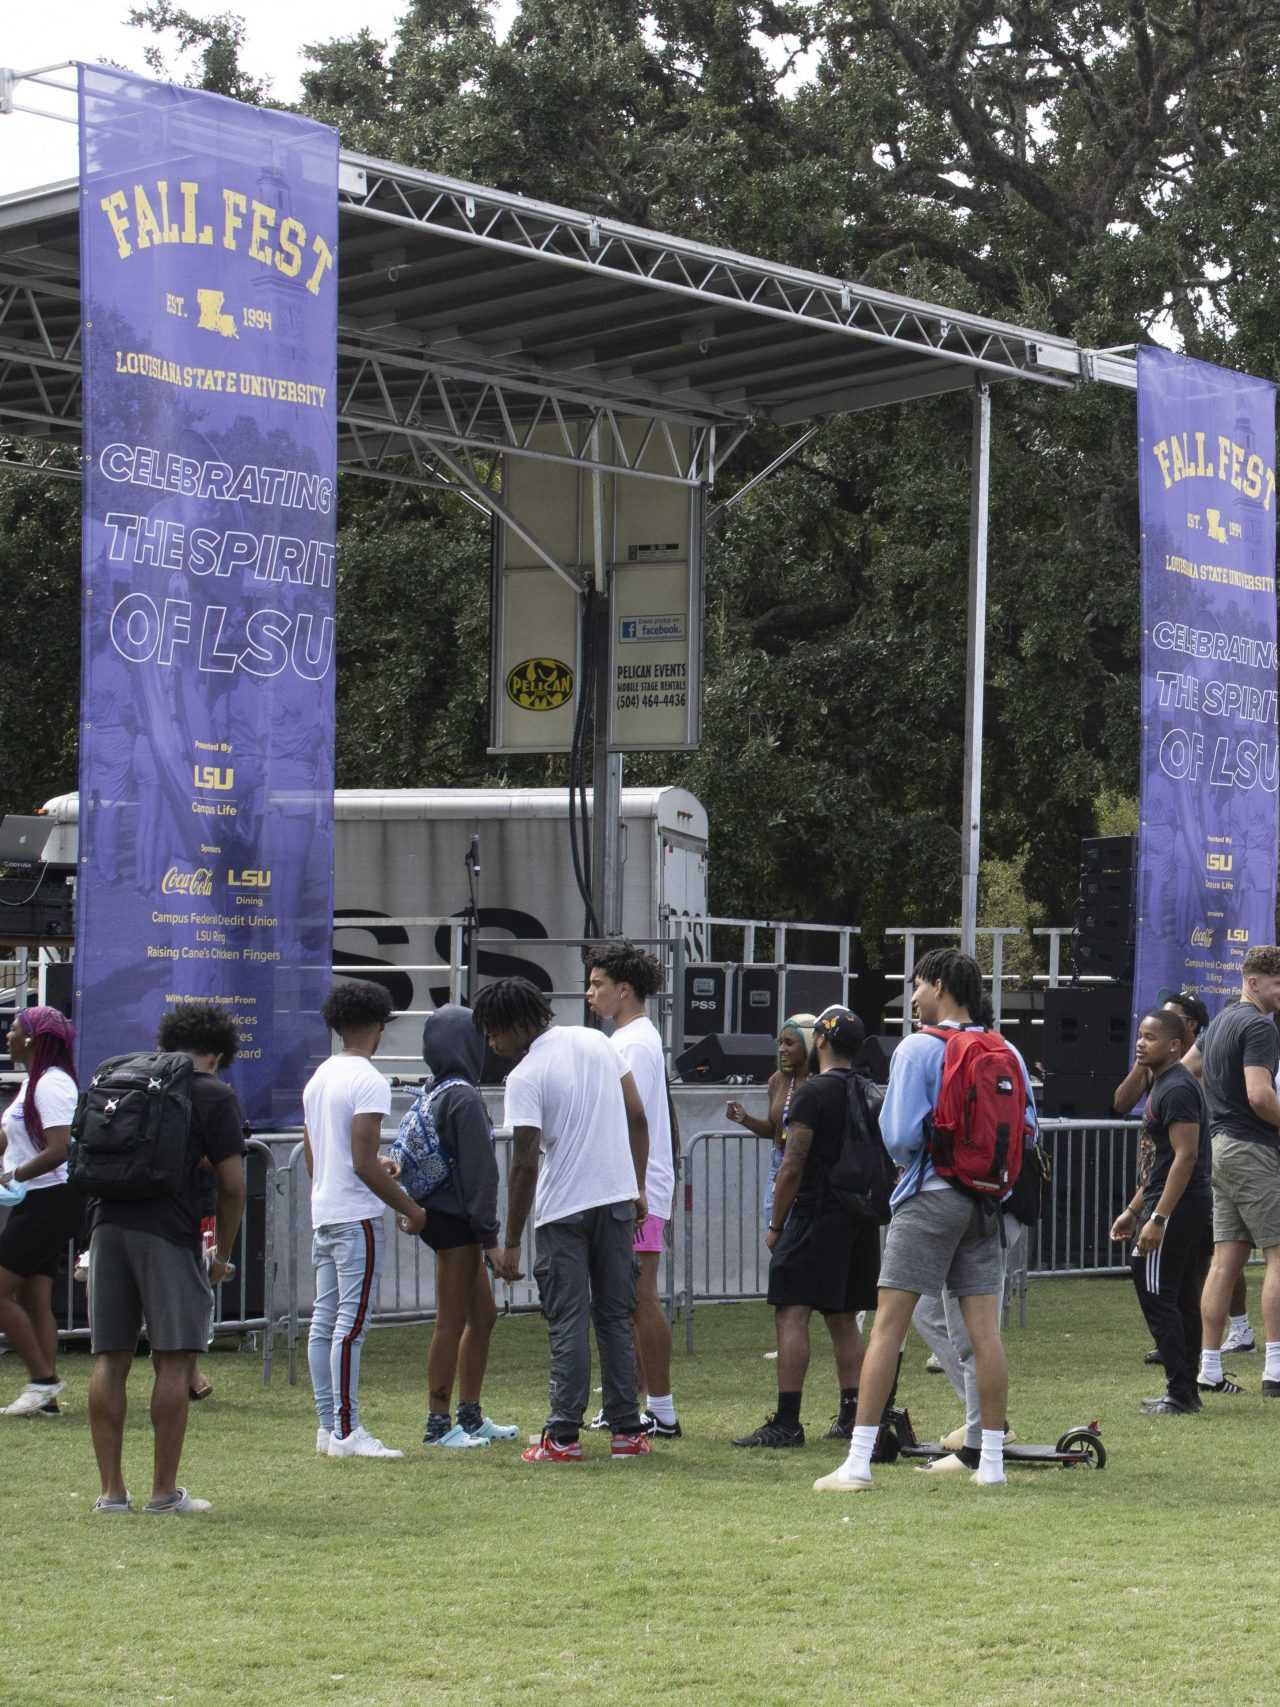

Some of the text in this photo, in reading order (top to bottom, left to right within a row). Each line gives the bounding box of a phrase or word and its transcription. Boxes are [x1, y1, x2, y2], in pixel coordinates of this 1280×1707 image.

[101, 181, 333, 295] FALL FEST
[166, 293, 272, 330] EST. 1994
[116, 352, 326, 408] LOUISIANA STATE UNIVERSITY
[99, 443, 333, 513] CELEBRATING
[1153, 432, 1276, 511] FALL FEST
[104, 512, 335, 587] THE SPIRIT
[1200, 565, 1228, 584] STATE
[110, 593, 334, 680] OF LSU
[617, 664, 686, 679] PELICAN EVENTS
[512, 675, 570, 694] PELICAN
[1157, 671, 1198, 711] THE
[617, 695, 639, 710] (504)
[1159, 728, 1279, 792] OF LSU
[194, 765, 234, 790] LSU
[217, 805, 237, 815] Life
[1206, 853, 1232, 871] LSU
[228, 869, 271, 887] LSU
[236, 896, 263, 907] Dining
[152, 911, 189, 926] Campus
[248, 915, 278, 927] Union
[196, 930, 211, 941] LSU
[1227, 929, 1248, 942] LSU
[147, 946, 179, 960] Raising
[243, 949, 280, 962] Fingers
[234, 996, 256, 1004] From
[691, 1000, 716, 1010] PSS
